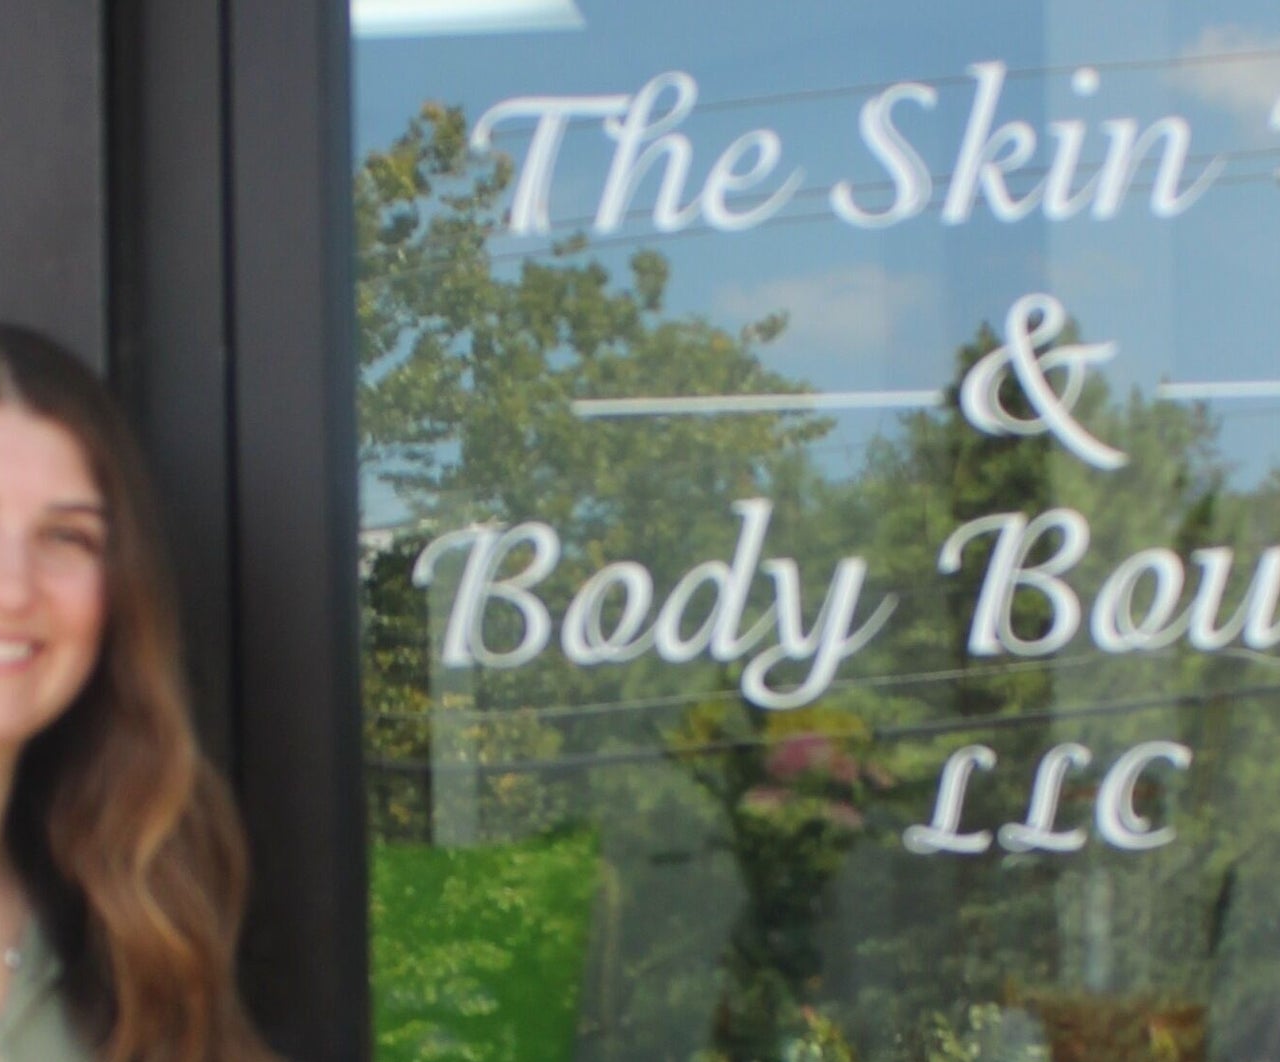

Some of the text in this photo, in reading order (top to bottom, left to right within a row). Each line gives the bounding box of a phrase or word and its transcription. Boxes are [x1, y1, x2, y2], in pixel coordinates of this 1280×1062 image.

[472, 70, 805, 234] The
[829, 60, 1226, 230] Skin
[959, 292, 1128, 469] &
[413, 496, 897, 710] Body
[903, 740, 1193, 855] LLC
